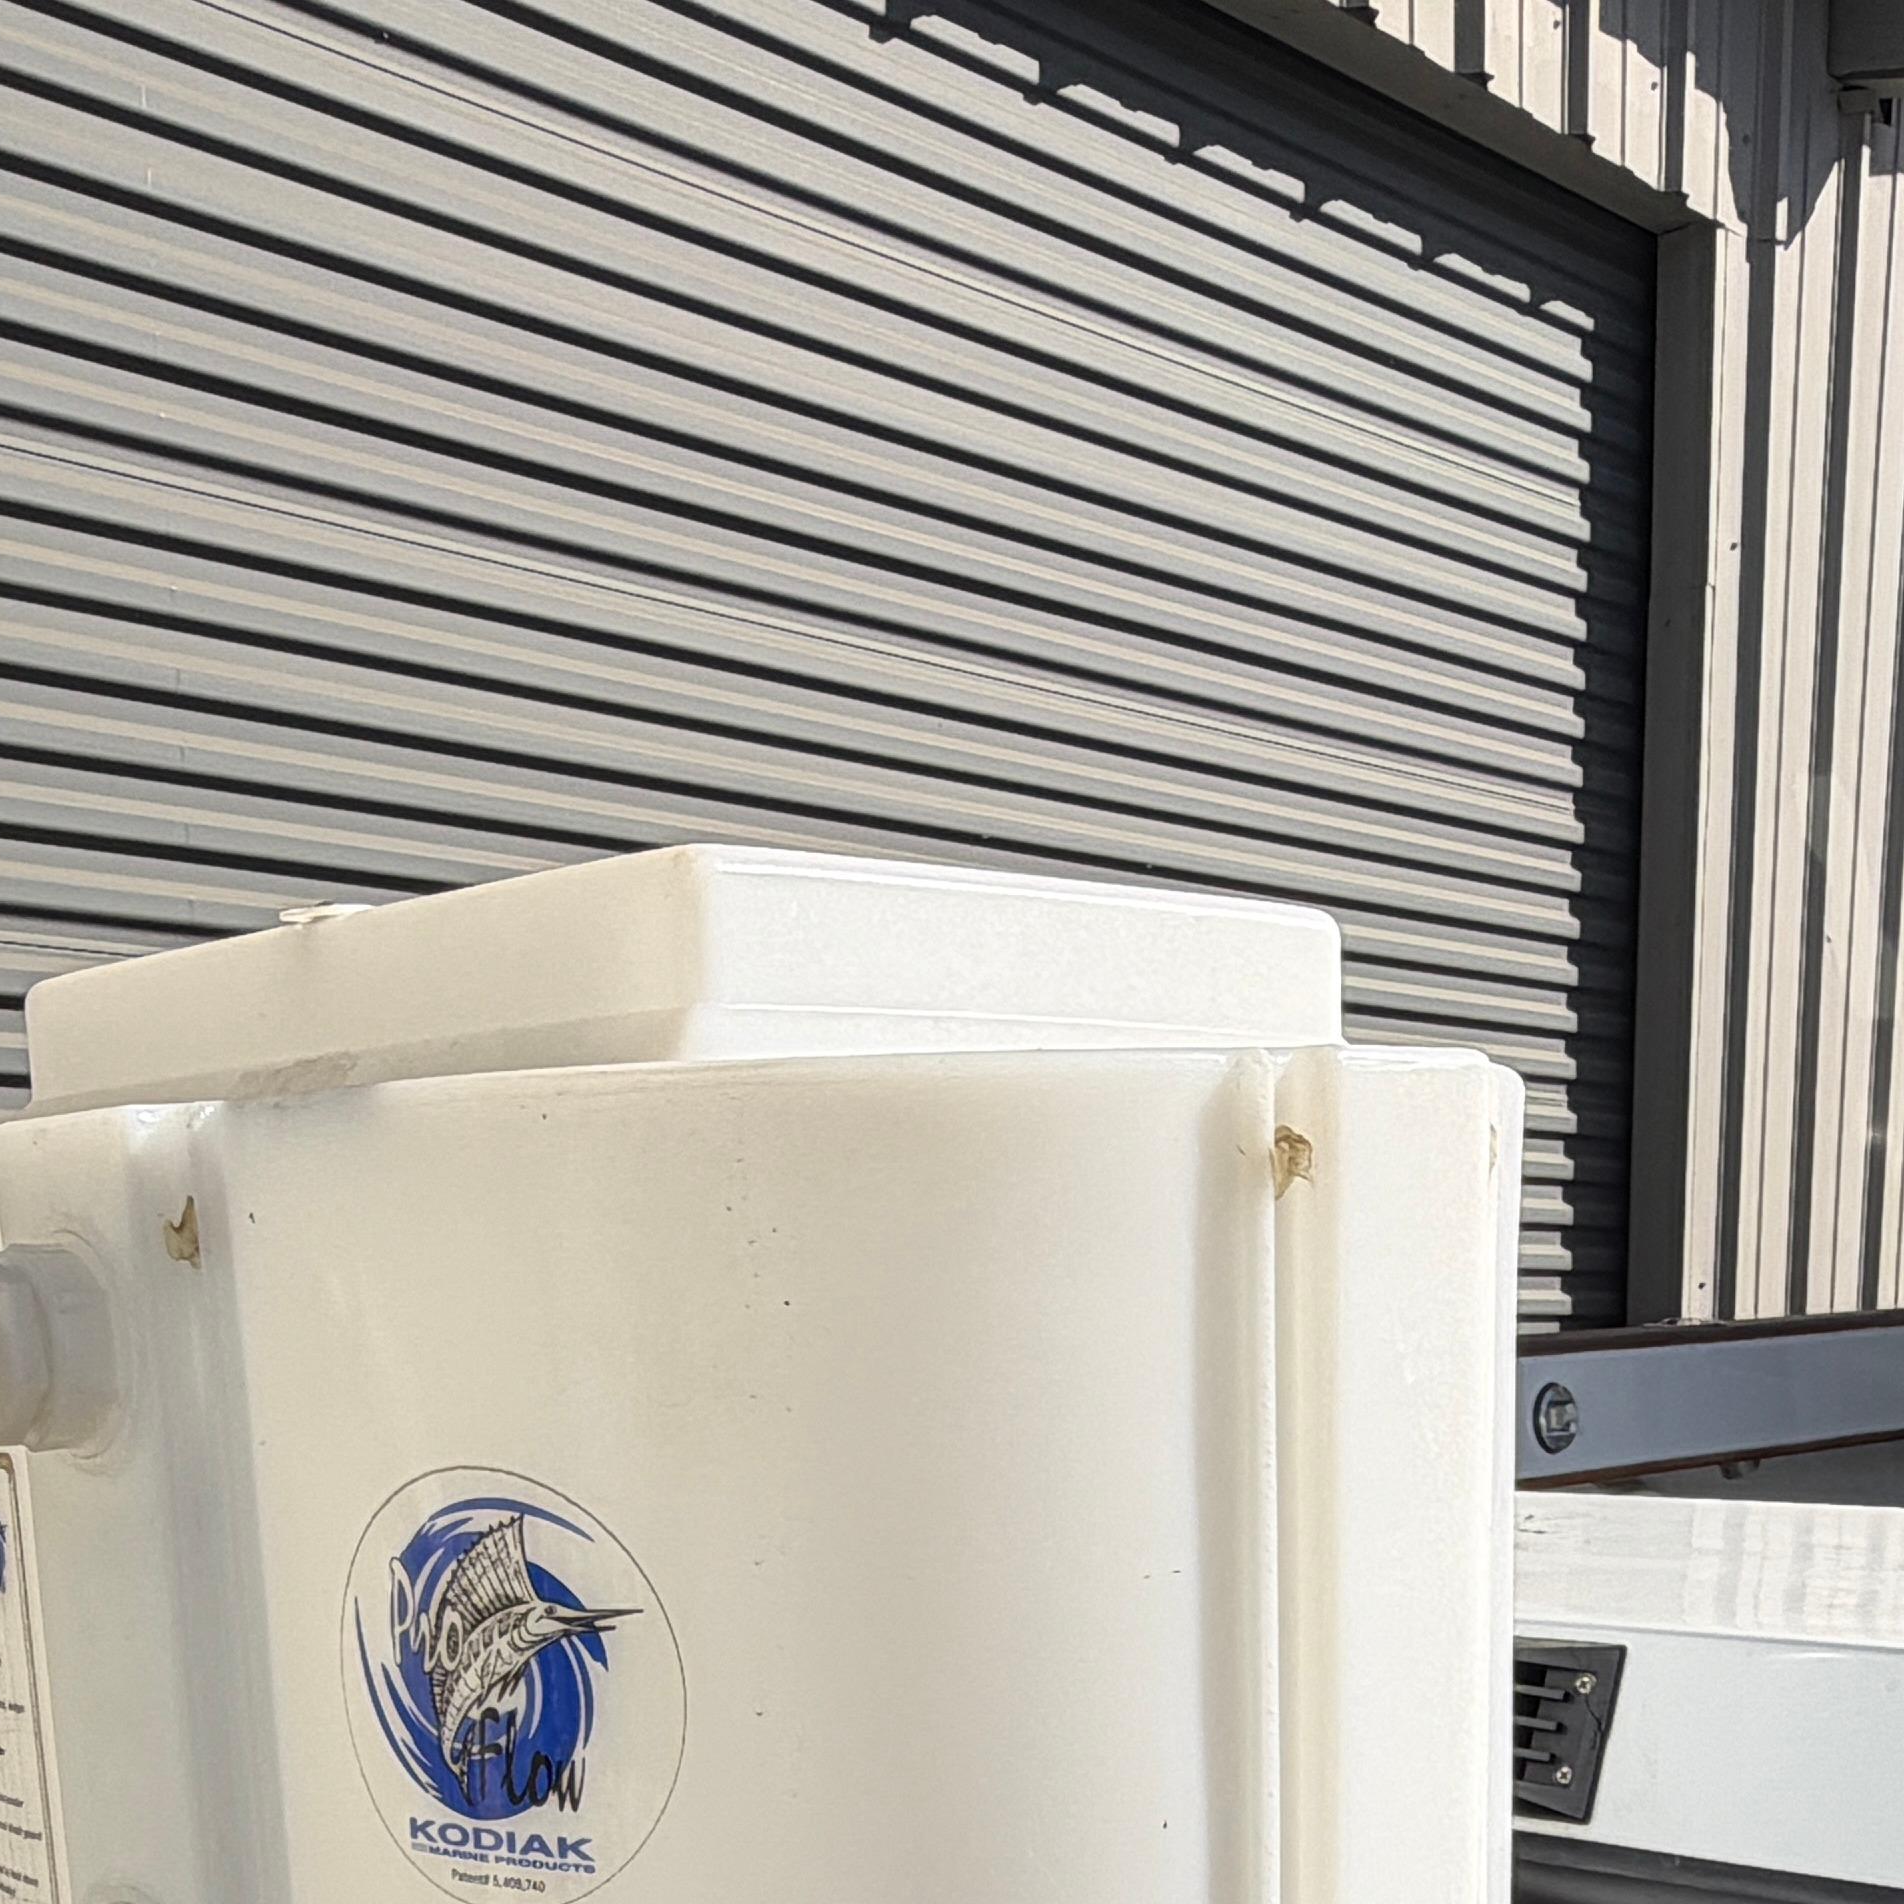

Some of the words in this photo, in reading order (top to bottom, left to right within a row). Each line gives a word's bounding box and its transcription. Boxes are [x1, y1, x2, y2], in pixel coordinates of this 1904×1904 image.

[388, 1556, 464, 1674] Pro
[462, 1706, 586, 1812] Flow
[409, 1816, 596, 1862] KODIAK
[428, 1845, 490, 1863] MARINE
[494, 1855, 596, 1875] PRODUCTS
